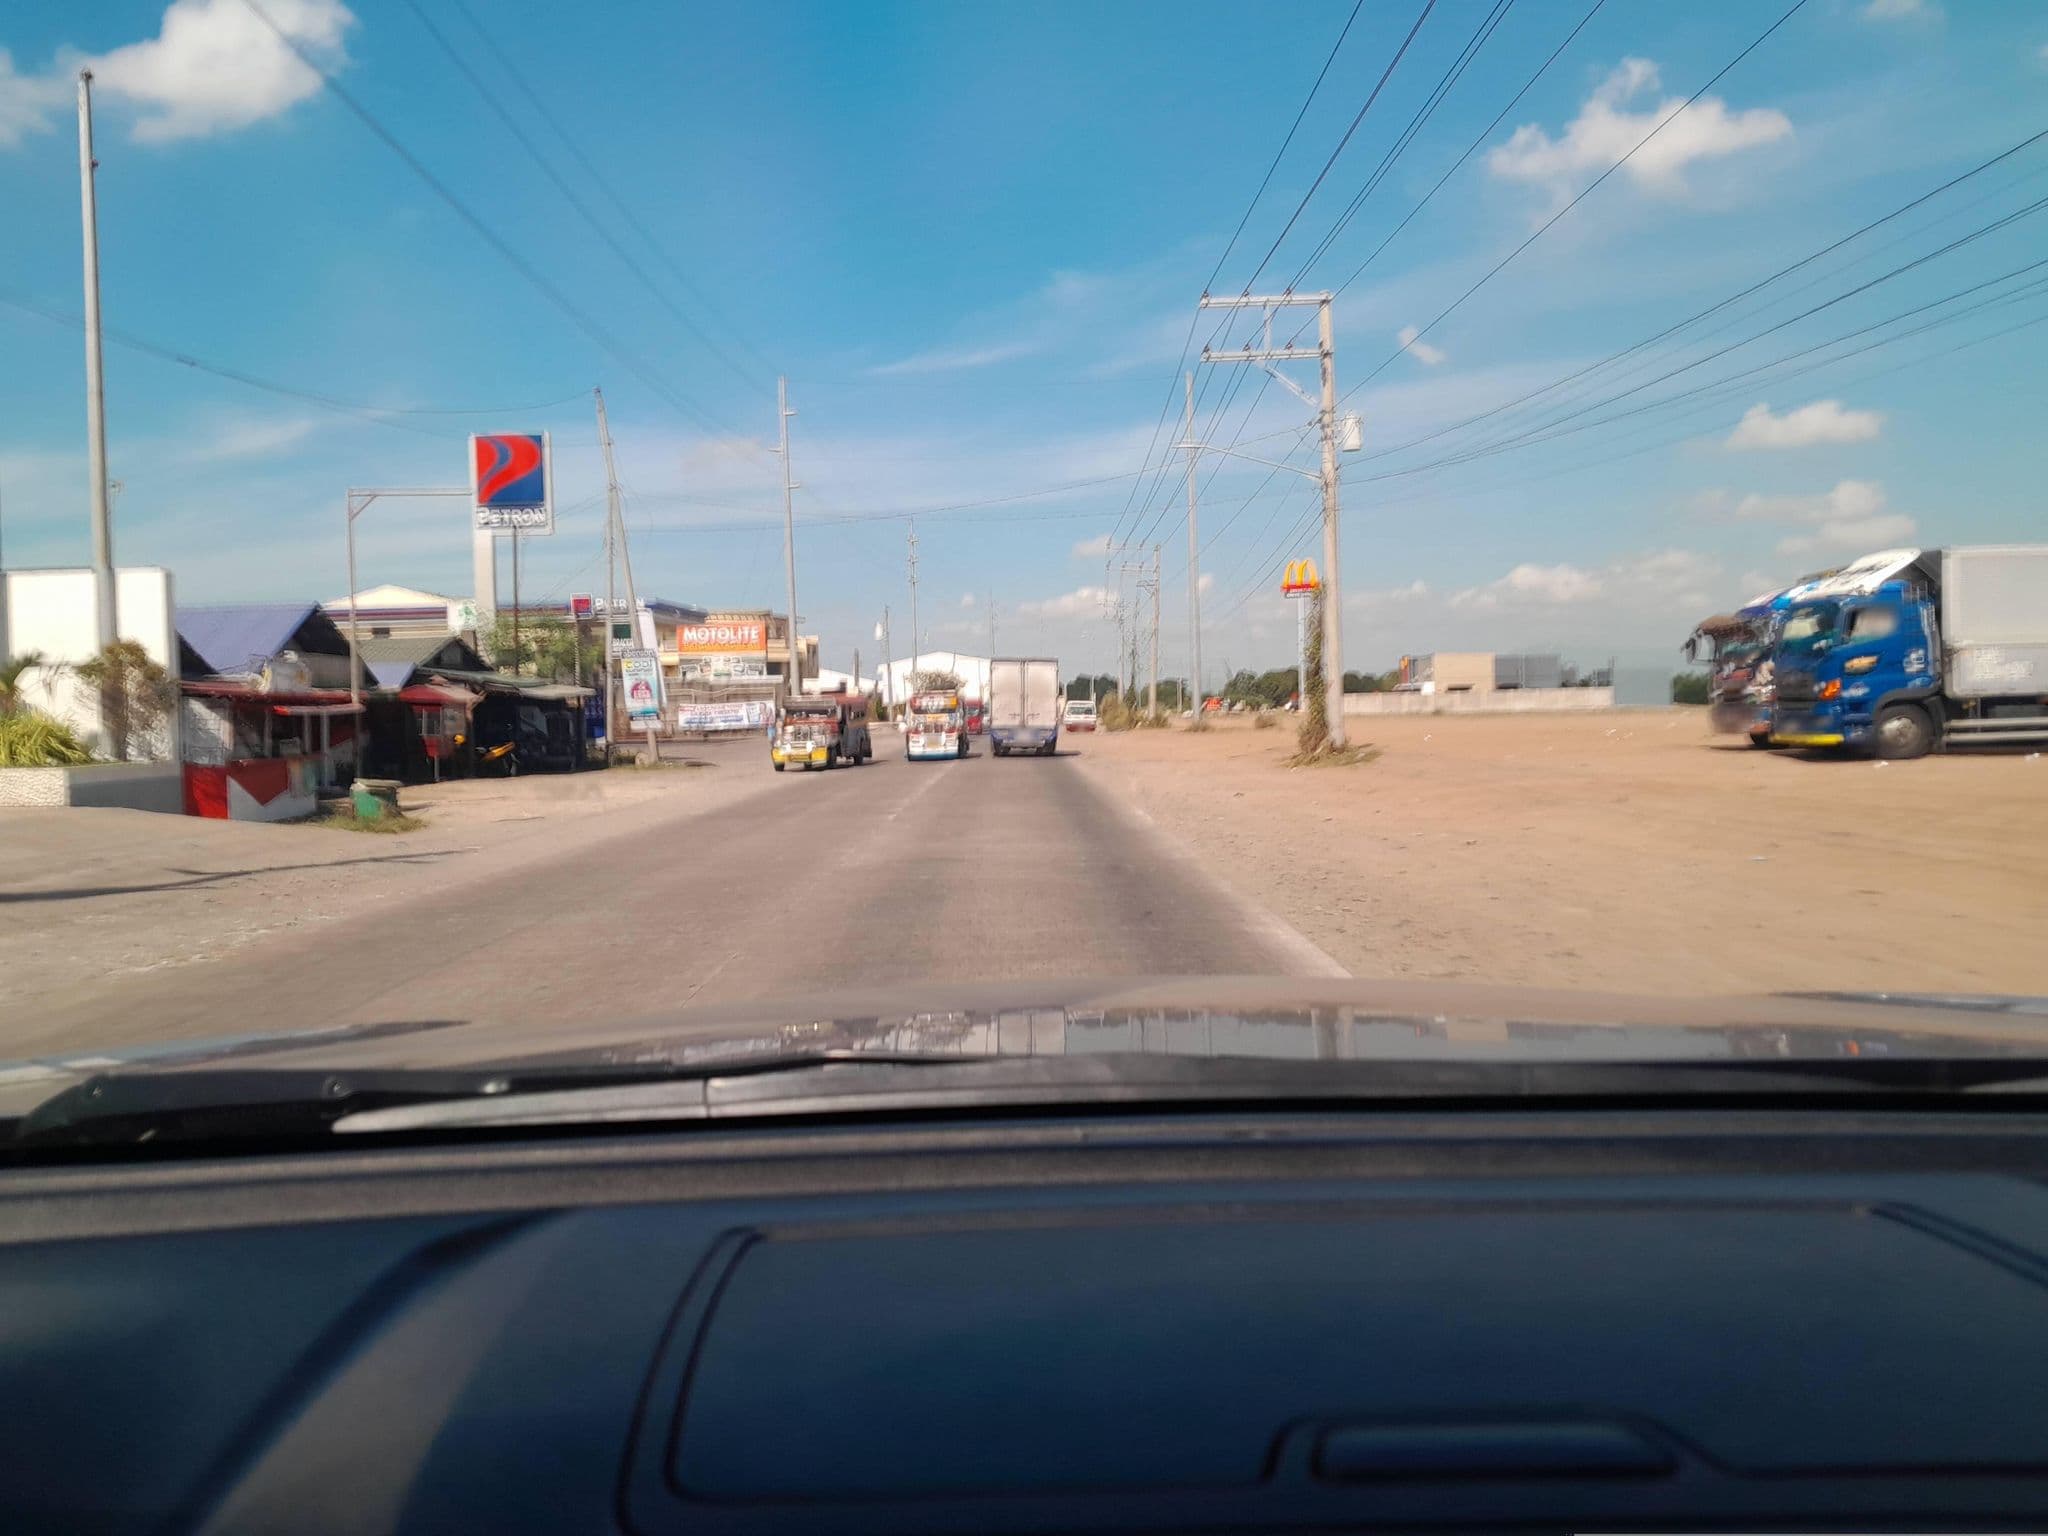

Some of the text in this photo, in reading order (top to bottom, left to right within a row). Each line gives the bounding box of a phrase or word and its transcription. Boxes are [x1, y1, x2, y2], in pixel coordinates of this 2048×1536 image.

[477, 507, 545, 526] PETRON
[595, 598, 645, 608] PTRN
[684, 625, 759, 643] MOTOLITE
